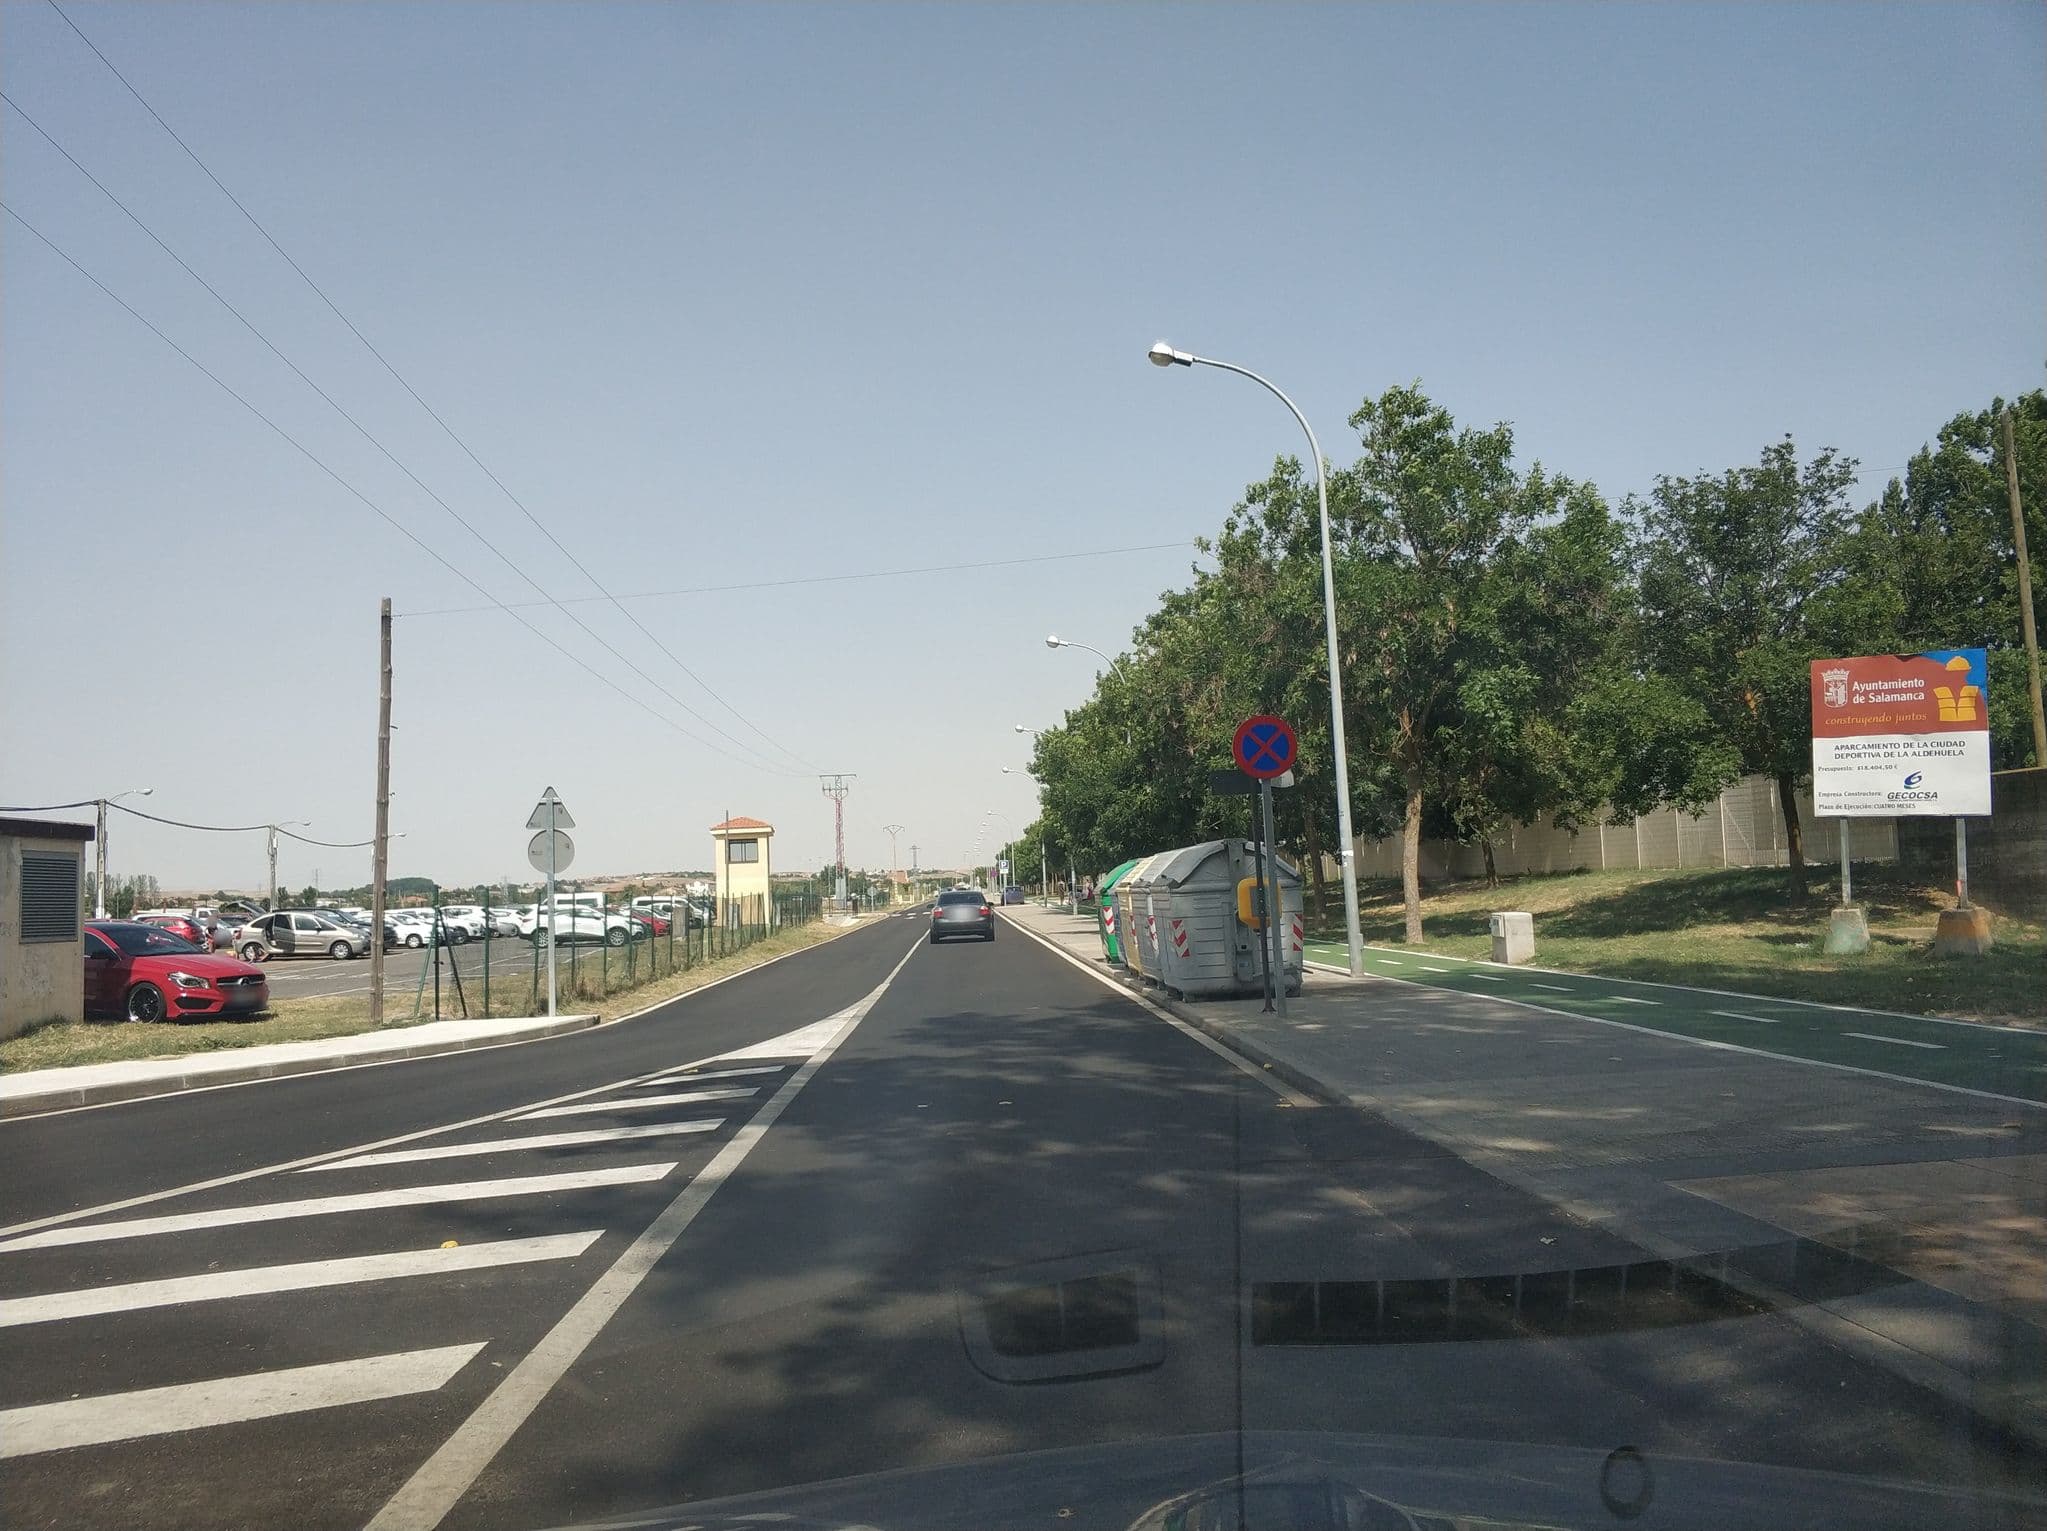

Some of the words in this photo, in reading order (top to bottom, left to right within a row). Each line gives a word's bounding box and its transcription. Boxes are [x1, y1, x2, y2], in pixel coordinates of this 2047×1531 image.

[1852, 678, 1925, 693] Ayuntamiento
[1852, 694, 1865, 704] de
[1868, 692, 1925, 704] Salamanca
[1825, 713, 1892, 726] construyendo
[1894, 712, 1927, 724] juntos
[1834, 742, 1901, 751] APARCAMIENTO
[1930, 740, 1966, 748] CIUDAD
[1834, 751, 1881, 760] DEPORTIVA
[1883, 751, 1895, 759] DE
[1911, 749, 1964, 758] ALDEHUELA
[1887, 791, 1938, 800] GECOCSA
